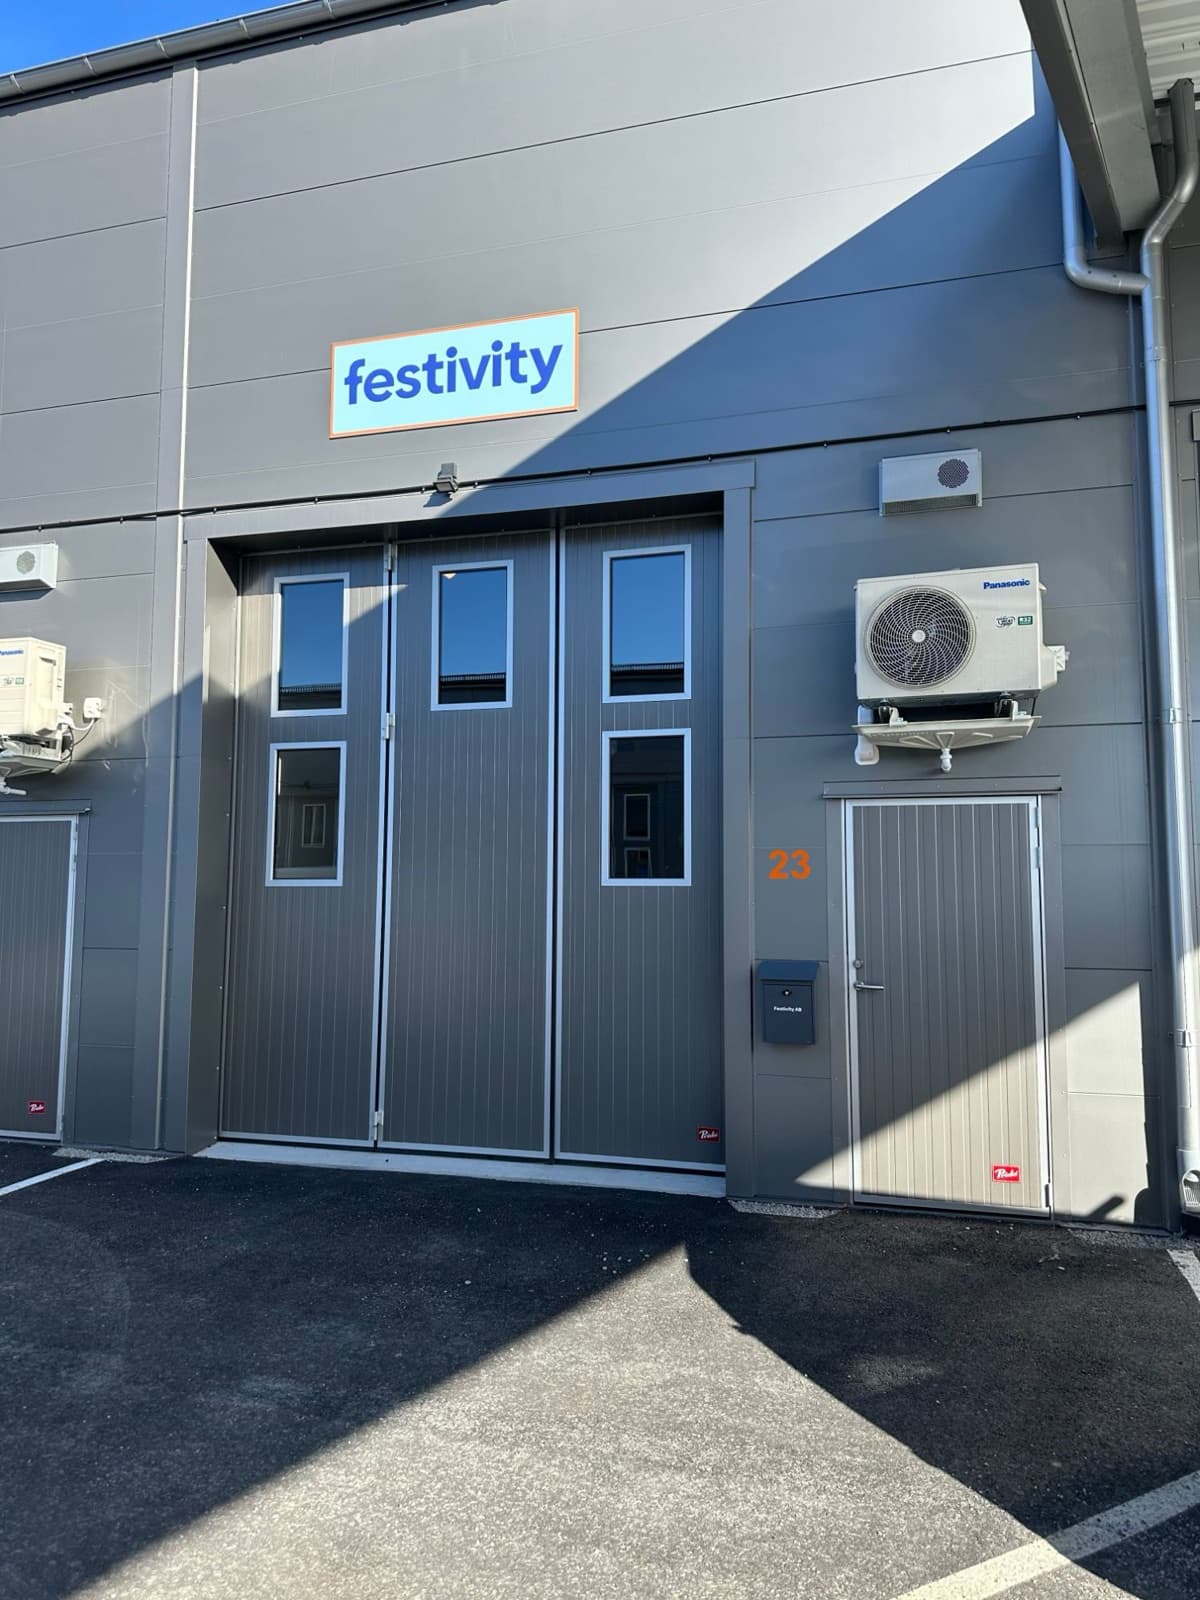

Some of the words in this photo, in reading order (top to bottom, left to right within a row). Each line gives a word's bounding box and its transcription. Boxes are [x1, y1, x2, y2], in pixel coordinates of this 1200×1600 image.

[344, 340, 563, 405] festivity
[983, 579, 1031, 589] Panasonic
[768, 848, 811, 880] 23
[773, 1005, 794, 1013] Festivity
